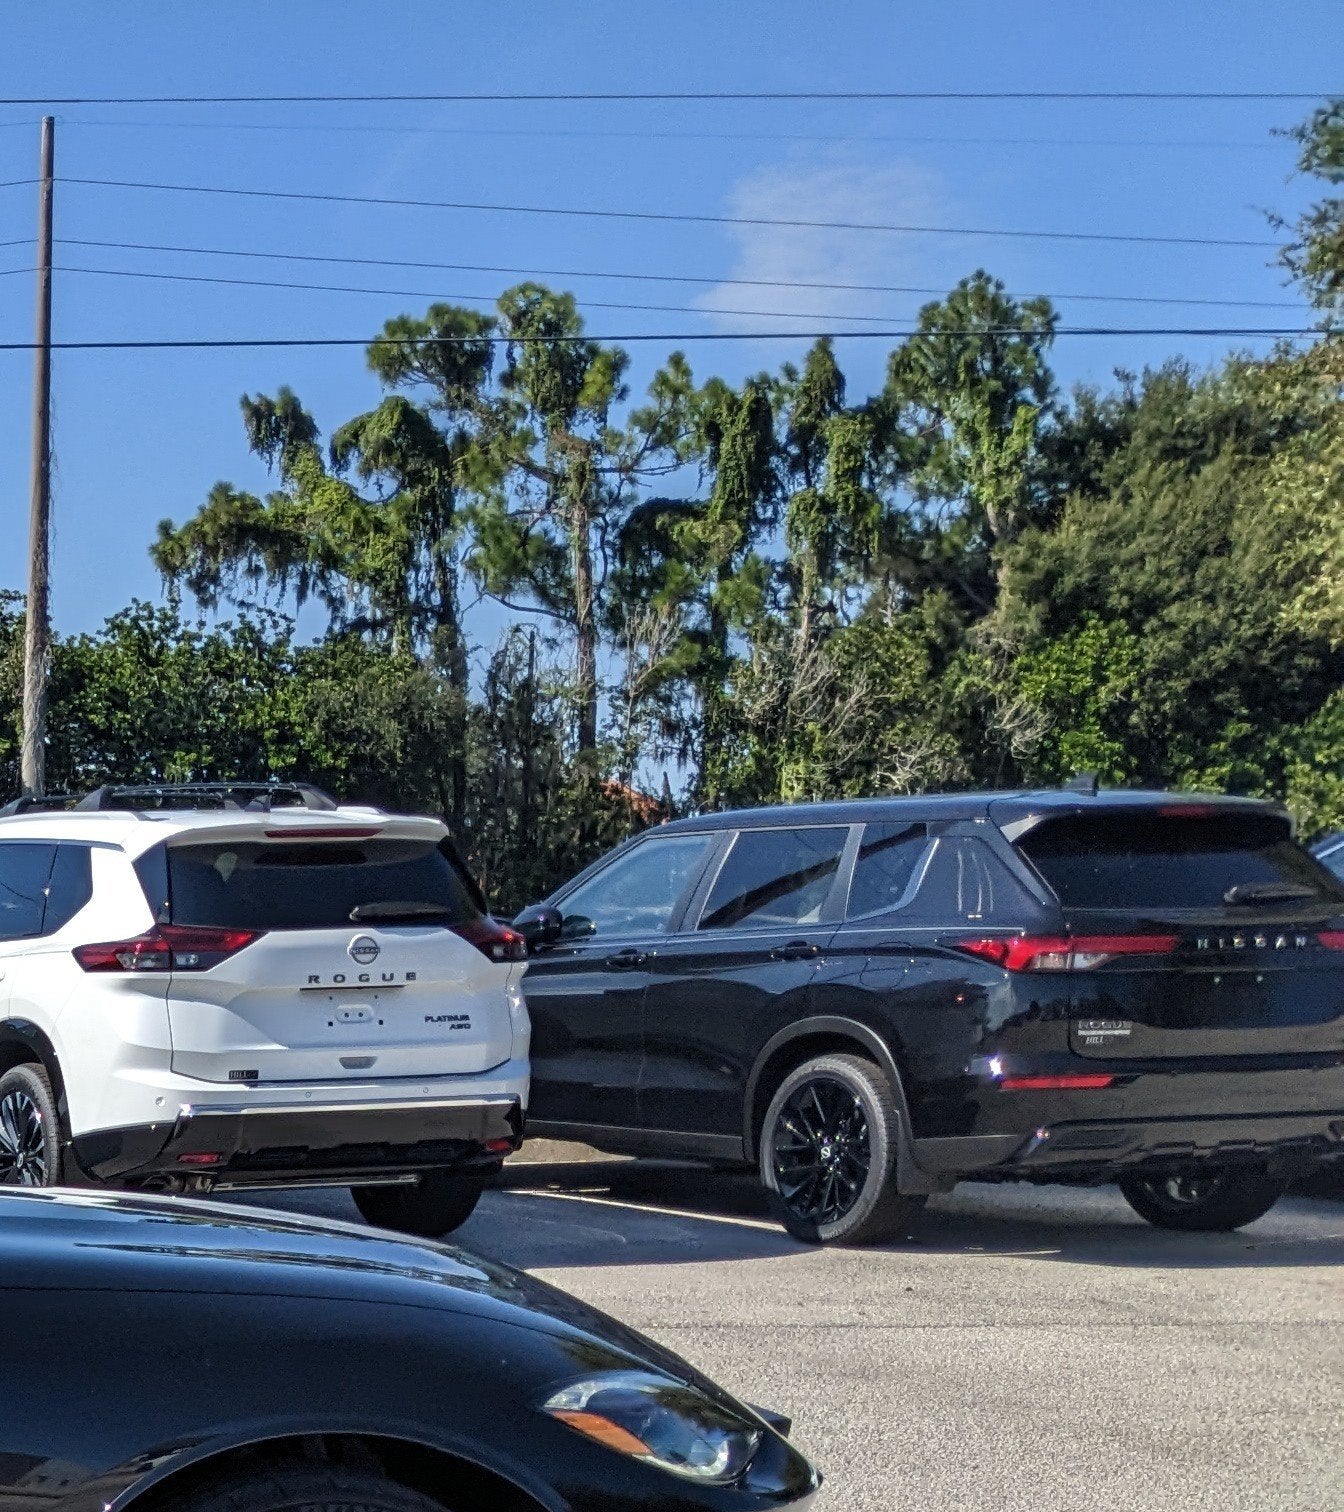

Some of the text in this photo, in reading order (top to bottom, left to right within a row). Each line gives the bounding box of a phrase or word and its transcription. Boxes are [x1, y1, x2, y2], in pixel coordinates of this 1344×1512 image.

[1197, 935, 1306, 949] NISSAN
[308, 972, 417, 984] ROGUE
[424, 1014, 471, 1023] PLATINUM
